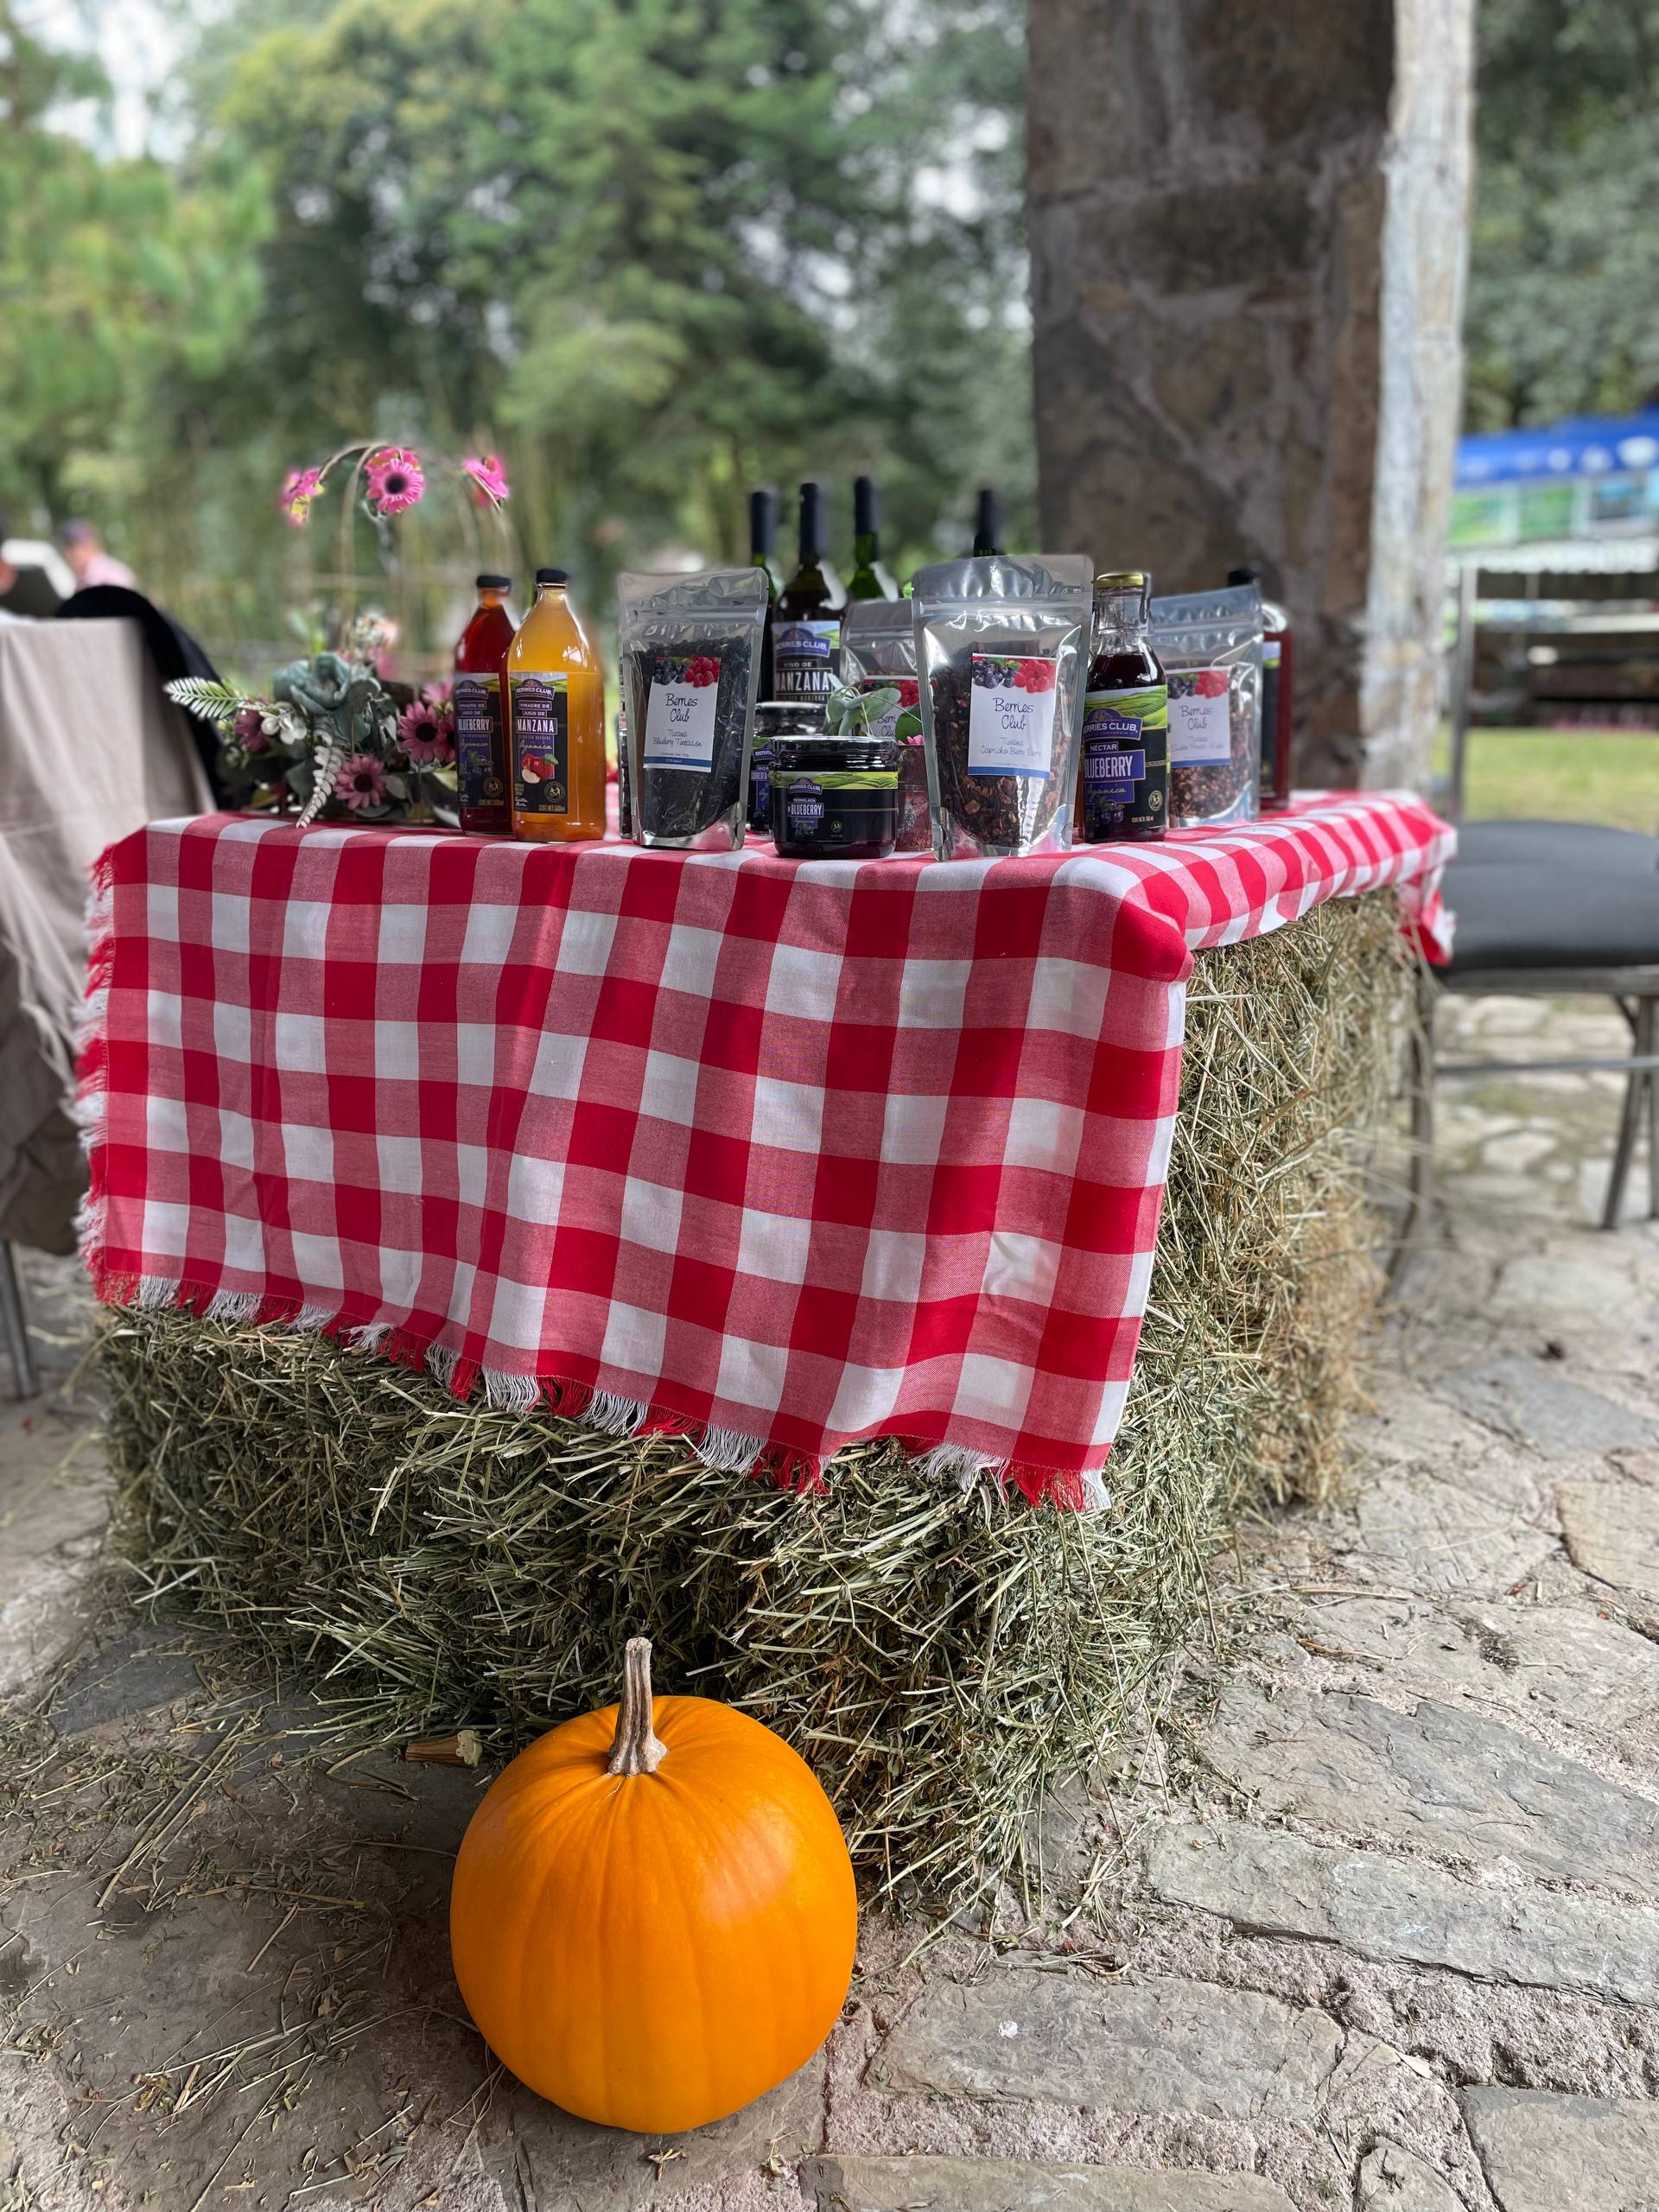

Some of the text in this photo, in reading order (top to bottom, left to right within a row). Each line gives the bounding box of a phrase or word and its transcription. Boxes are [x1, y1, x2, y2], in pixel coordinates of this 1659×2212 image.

[665, 693, 698, 707] Berries
[992, 697, 1034, 713] Berries
[670, 709, 690, 722] Club
[1178, 705, 1212, 717] Berries
[458, 718, 490, 731] BLUEBERRY
[517, 719, 554, 732] MANZANA
[1001, 715, 1026, 730] Club
[1187, 716, 1207, 730] Club
[881, 725, 894, 737] Clu
[791, 804, 822, 816] BLUEBERRY
